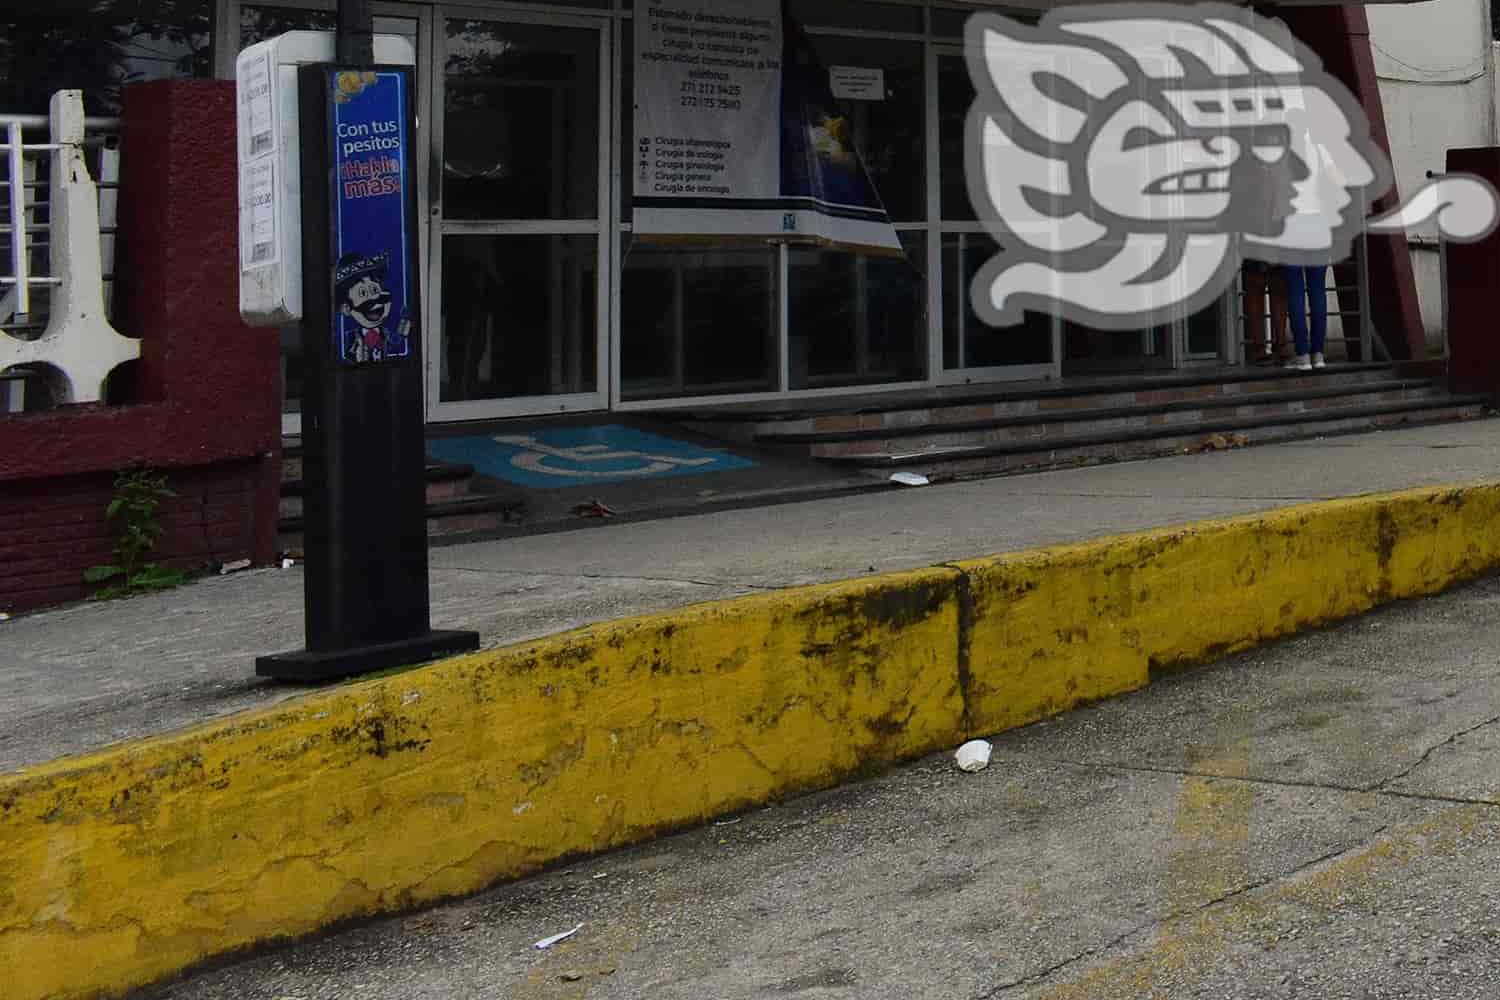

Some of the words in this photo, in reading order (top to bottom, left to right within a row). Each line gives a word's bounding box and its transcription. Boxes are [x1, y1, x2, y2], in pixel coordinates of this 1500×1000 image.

[337, 122, 369, 138] Con
[372, 120, 398, 134] tus
[343, 135, 400, 158] pesitos
